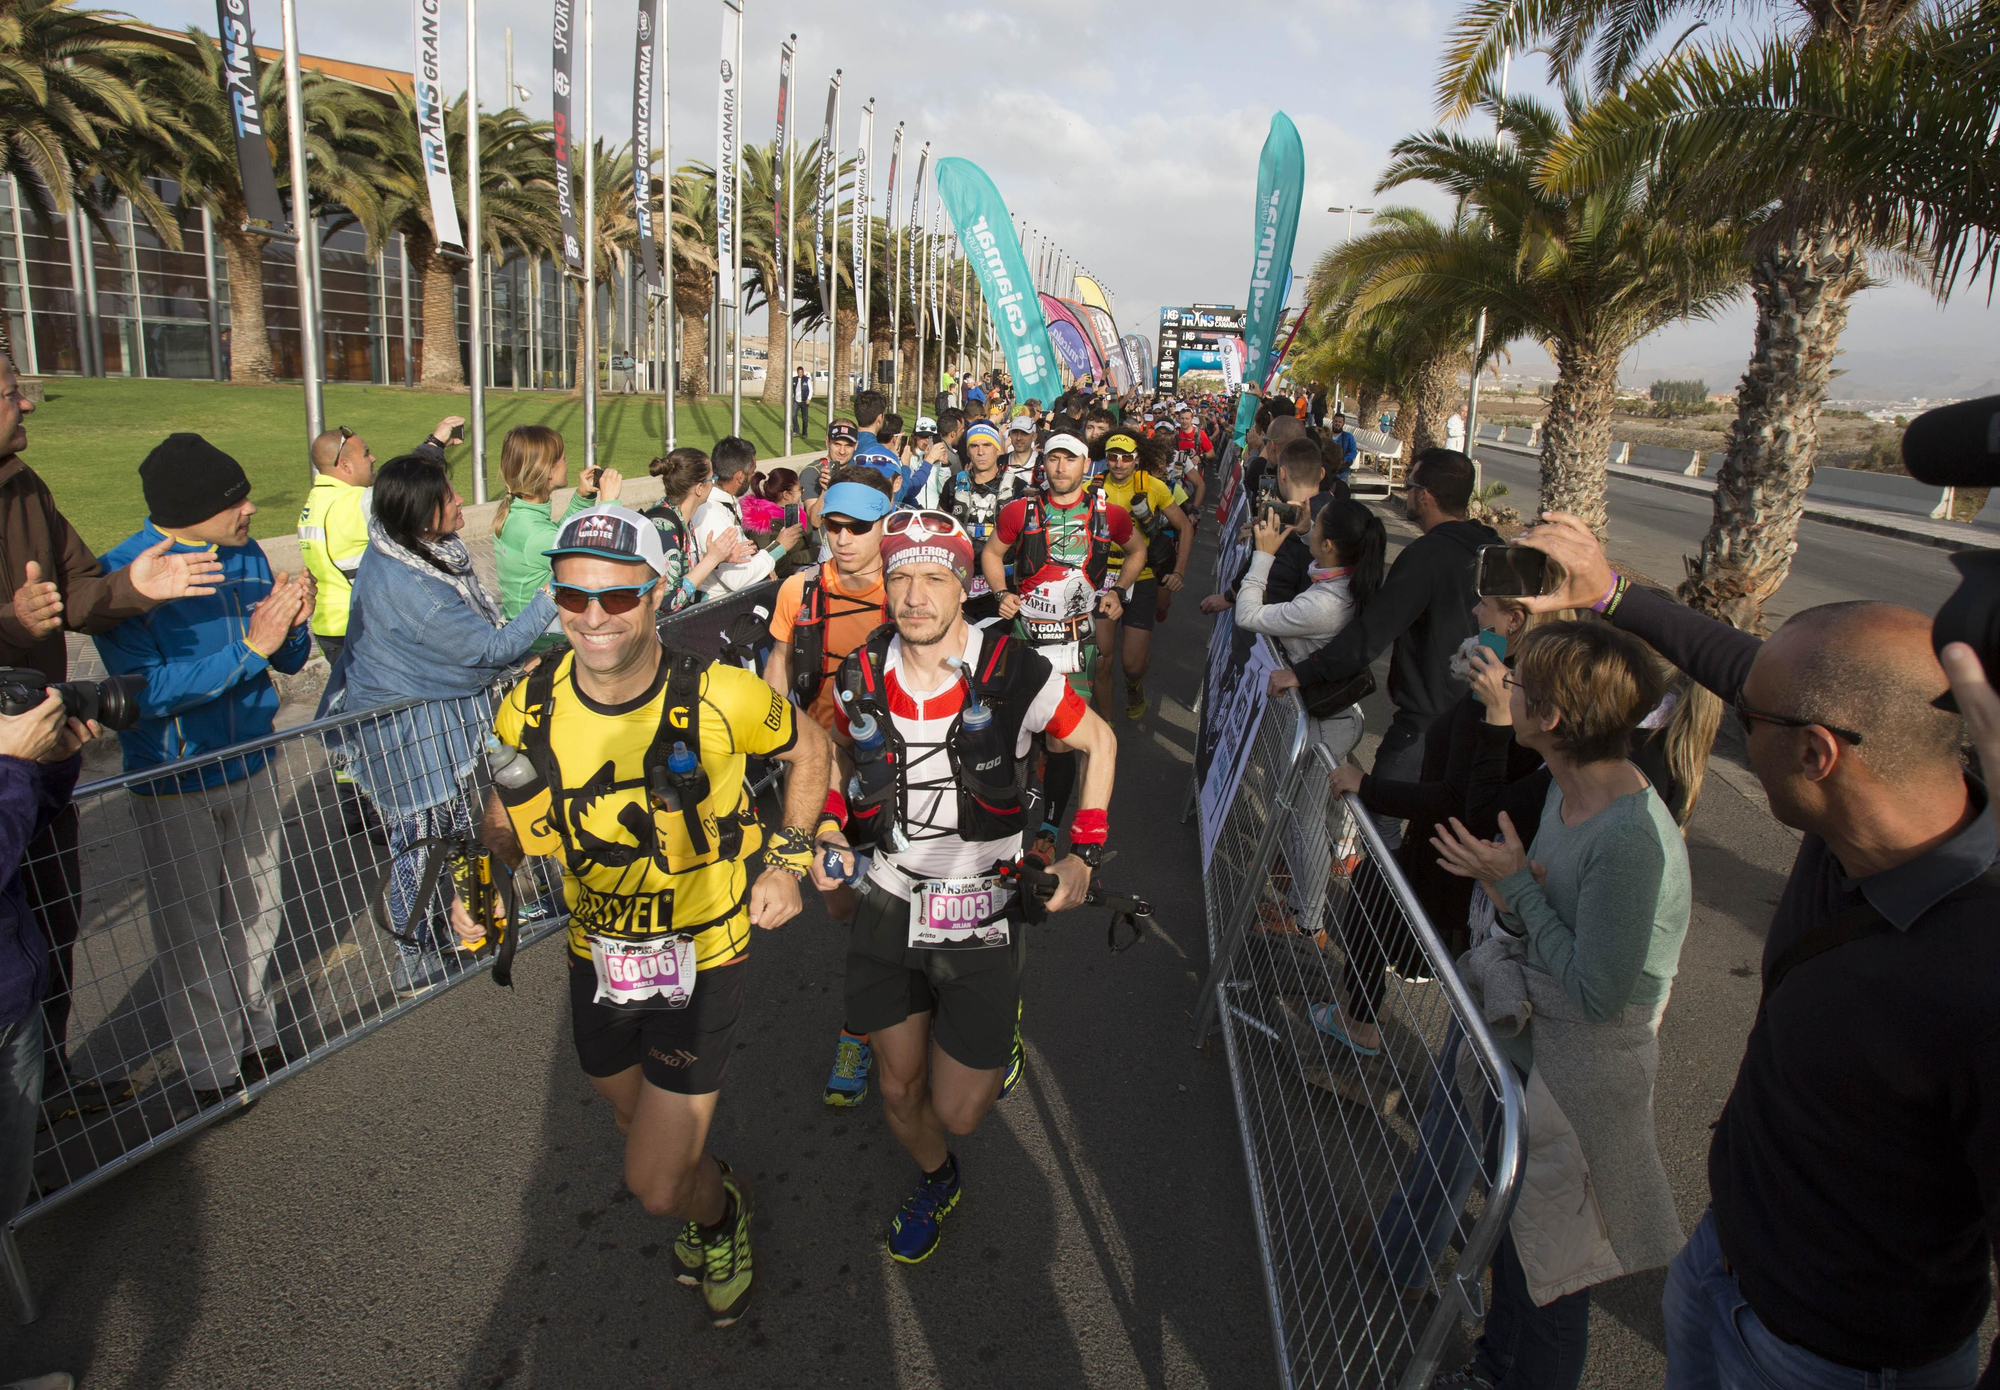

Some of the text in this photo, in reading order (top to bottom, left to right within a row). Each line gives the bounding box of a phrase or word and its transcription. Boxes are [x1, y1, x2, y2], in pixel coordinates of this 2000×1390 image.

[422, 16, 438, 81] GRAN
[223, 16, 261, 138] TRANS
[639, 45, 652, 119] CANARIA
[419, 81, 447, 177] TRANS
[553, 110, 566, 162] HG
[638, 120, 648, 168] GRAN
[722, 88, 734, 152] CANARIA
[556, 160, 572, 218] SPORT
[723, 153, 731, 193] GRAN
[818, 147, 830, 198] CANARIA
[857, 168, 866, 215] CANARIA
[634, 169, 651, 239] TRANS
[719, 194, 730, 255] TRANS
[817, 199, 825, 232] GRAN
[856, 216, 864, 246] GRAN
[816, 232, 825, 283] TRANS
[855, 247, 863, 290] TRANS
[579, 530, 613, 539] WILD TEE
[1038, 623, 1067, 632] GOAL
[931, 894, 989, 922] 6003
[607, 951, 676, 982] 6006
[632, 979, 654, 989] PABLO
